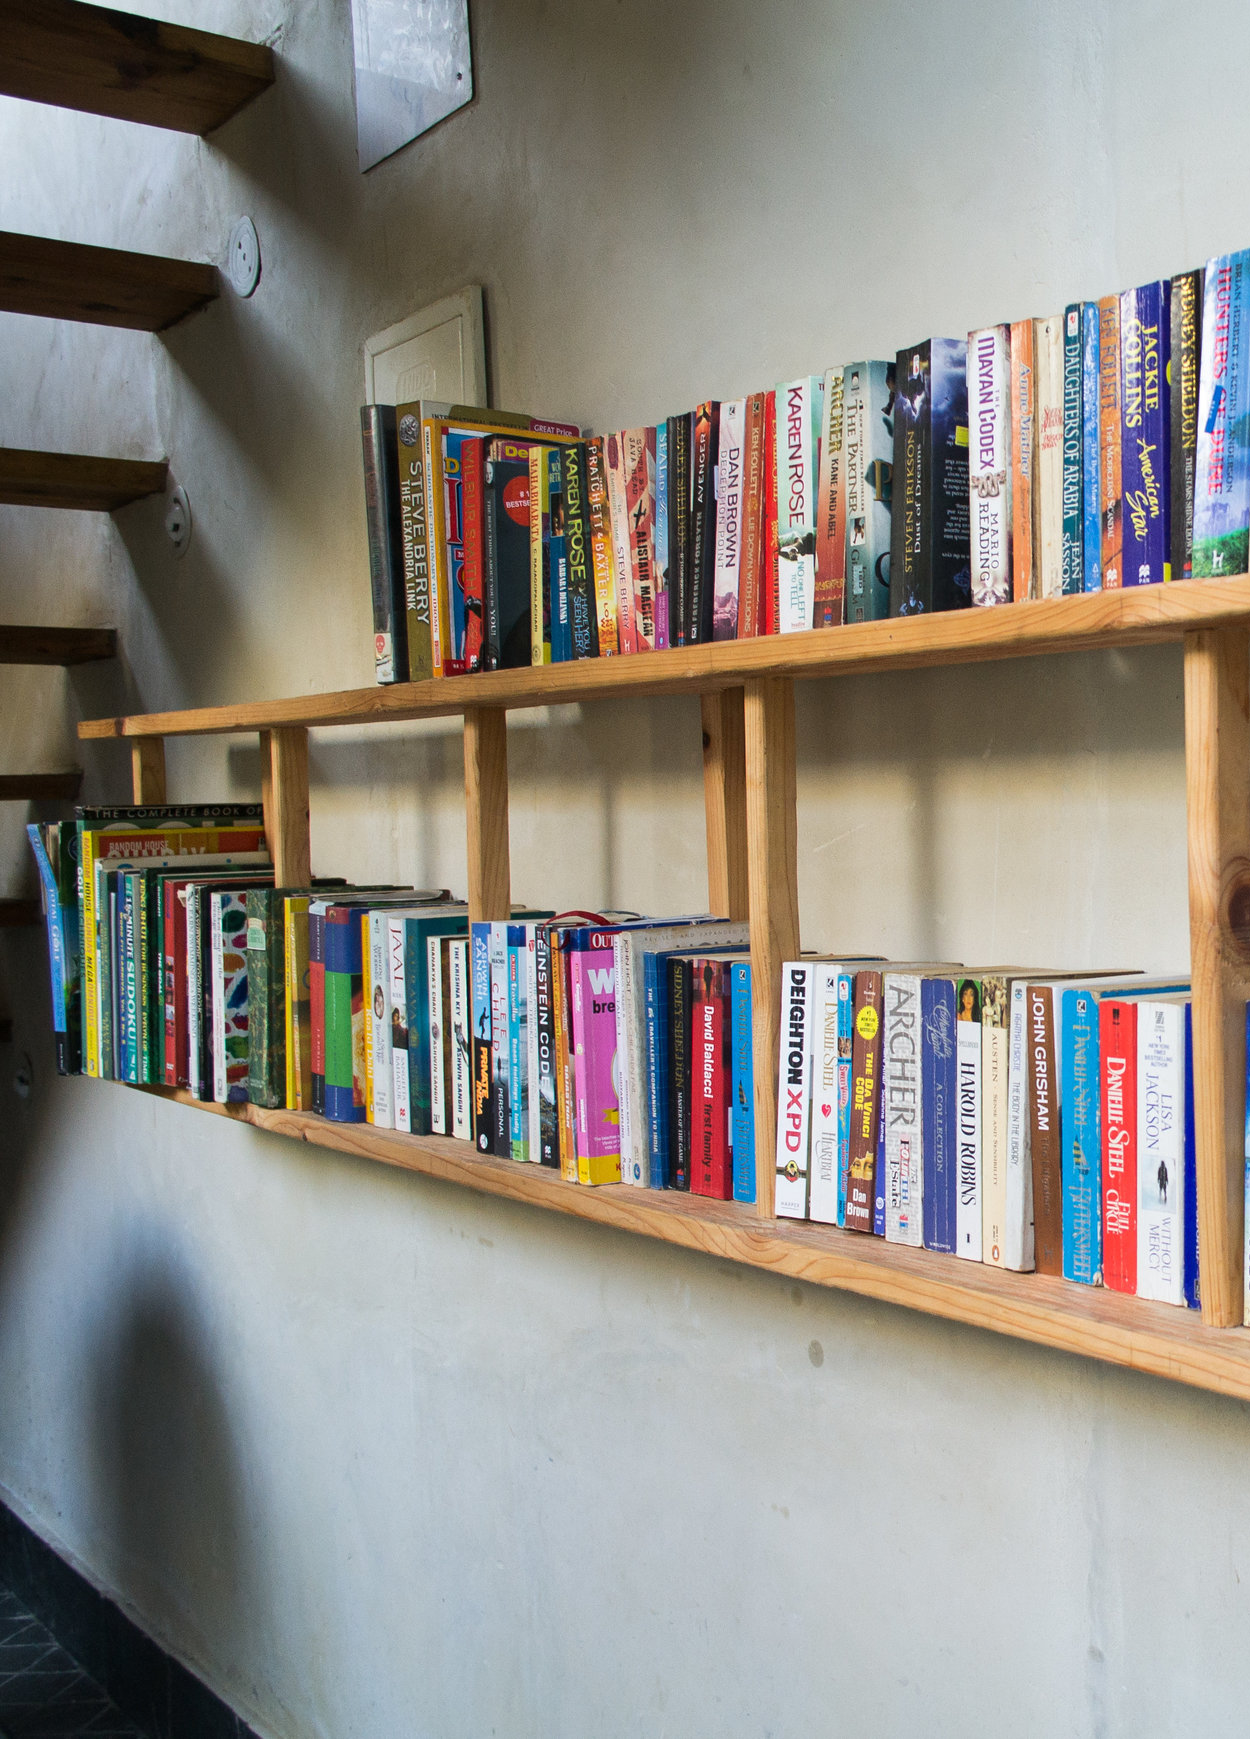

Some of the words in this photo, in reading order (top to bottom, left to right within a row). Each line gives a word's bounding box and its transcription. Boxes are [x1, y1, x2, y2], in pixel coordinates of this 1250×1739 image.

[1181, 276, 1196, 349] SIDNEY
[1213, 267, 1232, 379] HUNTERS
[977, 336, 995, 405] MAYAN
[1065, 343, 1080, 438] DAUGHTERS
[1125, 318, 1143, 429] COLLINS
[1142, 324, 1159, 413] JACKIE
[787, 386, 803, 460] KAREN
[828, 375, 844, 455] ARCHER
[847, 400, 857, 437] THE
[1181, 354, 1196, 449] SHELDON
[534, 424, 555, 434] GREAT
[556, 429, 573, 437] Price
[978, 409, 997, 470] CODEX
[1064, 441, 1079, 460] OF
[463, 440, 476, 521] WILBUR
[566, 448, 581, 515] KAREN
[588, 446, 604, 530] PRATCHETT
[697, 433, 706, 503] AVENGER
[718, 450, 728, 525] DECEPTION
[728, 448, 740, 489] DAN
[830, 458, 838, 487] KANE
[847, 442, 858, 515] PARTNER
[906, 431, 915, 505] ERIKSON
[1137, 437, 1160, 519] American
[1208, 429, 1225, 496] DUNE
[401, 480, 411, 503] THE
[409, 461, 426, 537] STEVE
[530, 458, 540, 543] MAHABHARATA
[789, 463, 805, 528] ROSE
[828, 489, 837, 511] AND
[1064, 466, 1079, 519] ARABIA
[1125, 490, 1148, 543] Star
[401, 506, 415, 580] ALEXANDRIA
[568, 518, 586, 582] ROSE
[717, 531, 725, 569] POINT
[726, 494, 738, 569] BROWN
[828, 513, 836, 540] ABEL
[905, 512, 914, 573] STEVEN
[979, 502, 990, 582] READING
[991, 512, 1000, 570] MARIO
[413, 544, 430, 625] BERRY
[465, 528, 477, 590] SMITH
[558, 558, 566, 591] BARBARA
[595, 542, 608, 598] BAXTER
[617, 547, 626, 585] STEVE
[636, 531, 649, 582] ALISTAIR
[1062, 532, 1070, 590] SASSON
[1072, 541, 1080, 579] JEAN
[405, 583, 416, 611] LINK
[559, 592, 568, 624] DELINSKY
[574, 596, 582, 622] SEEN
[581, 598, 589, 626] HAVE
[620, 588, 630, 629] BERRY
[640, 585, 653, 637] MACLEAN
[575, 625, 584, 654] HER?
[583, 627, 591, 650] YOU
[95, 809, 120, 819] THE
[127, 808, 198, 818] COMPLETE
[203, 807, 240, 816] BOOK
[246, 806, 264, 816] OF
[109, 841, 143, 851] RANDOM
[145, 840, 169, 851] HOUSE
[390, 928, 404, 982] JAAL
[474, 937, 484, 1000] SANGHI
[536, 940, 551, 1026] EINSTEIN
[126, 960, 136, 1040] SUDOKU
[492, 982, 500, 1051] CHILD
[673, 966, 683, 1019] SIDNEY
[1032, 993, 1046, 1042] JOHN
[704, 1006, 714, 1041] David
[787, 969, 806, 1085] DEIGHTON
[480, 1046, 489, 1099] PRIVATE
[539, 1031, 551, 1087] CODE
[673, 1021, 684, 1089] SHELDON
[703, 1044, 714, 1098] Baldacci
[865, 1052, 874, 1076] THE
[889, 984, 916, 1128] ARCHER
[476, 1080, 484, 1115] INDIA
[497, 1087, 505, 1137] PERSONAL
[854, 1076, 865, 1110] CODE
[864, 1079, 874, 1098] DA
[960, 1062, 976, 1136] HAROLD
[1034, 1049, 1049, 1131] GRISHAM
[1106, 1056, 1127, 1125] DANIELLE
[1145, 1072, 1160, 1151] JACKSON
[1160, 1094, 1173, 1132] LISA
[785, 1089, 803, 1152] XPD
[862, 1101, 873, 1139] VINCI
[936, 1095, 944, 1172] COLLECTION
[815, 1131, 836, 1184] HEARTBEAT
[960, 1141, 977, 1206] ROBINS
[1107, 1127, 1130, 1179] STEEL
[847, 1202, 870, 1219] Brown
[852, 1189, 867, 1204] Dan
[1105, 1189, 1120, 1235] CIRCLE
[1116, 1201, 1131, 1235] FULL
[1148, 1225, 1160, 1273] MERCY
[1160, 1216, 1172, 1285] WITHOUT
